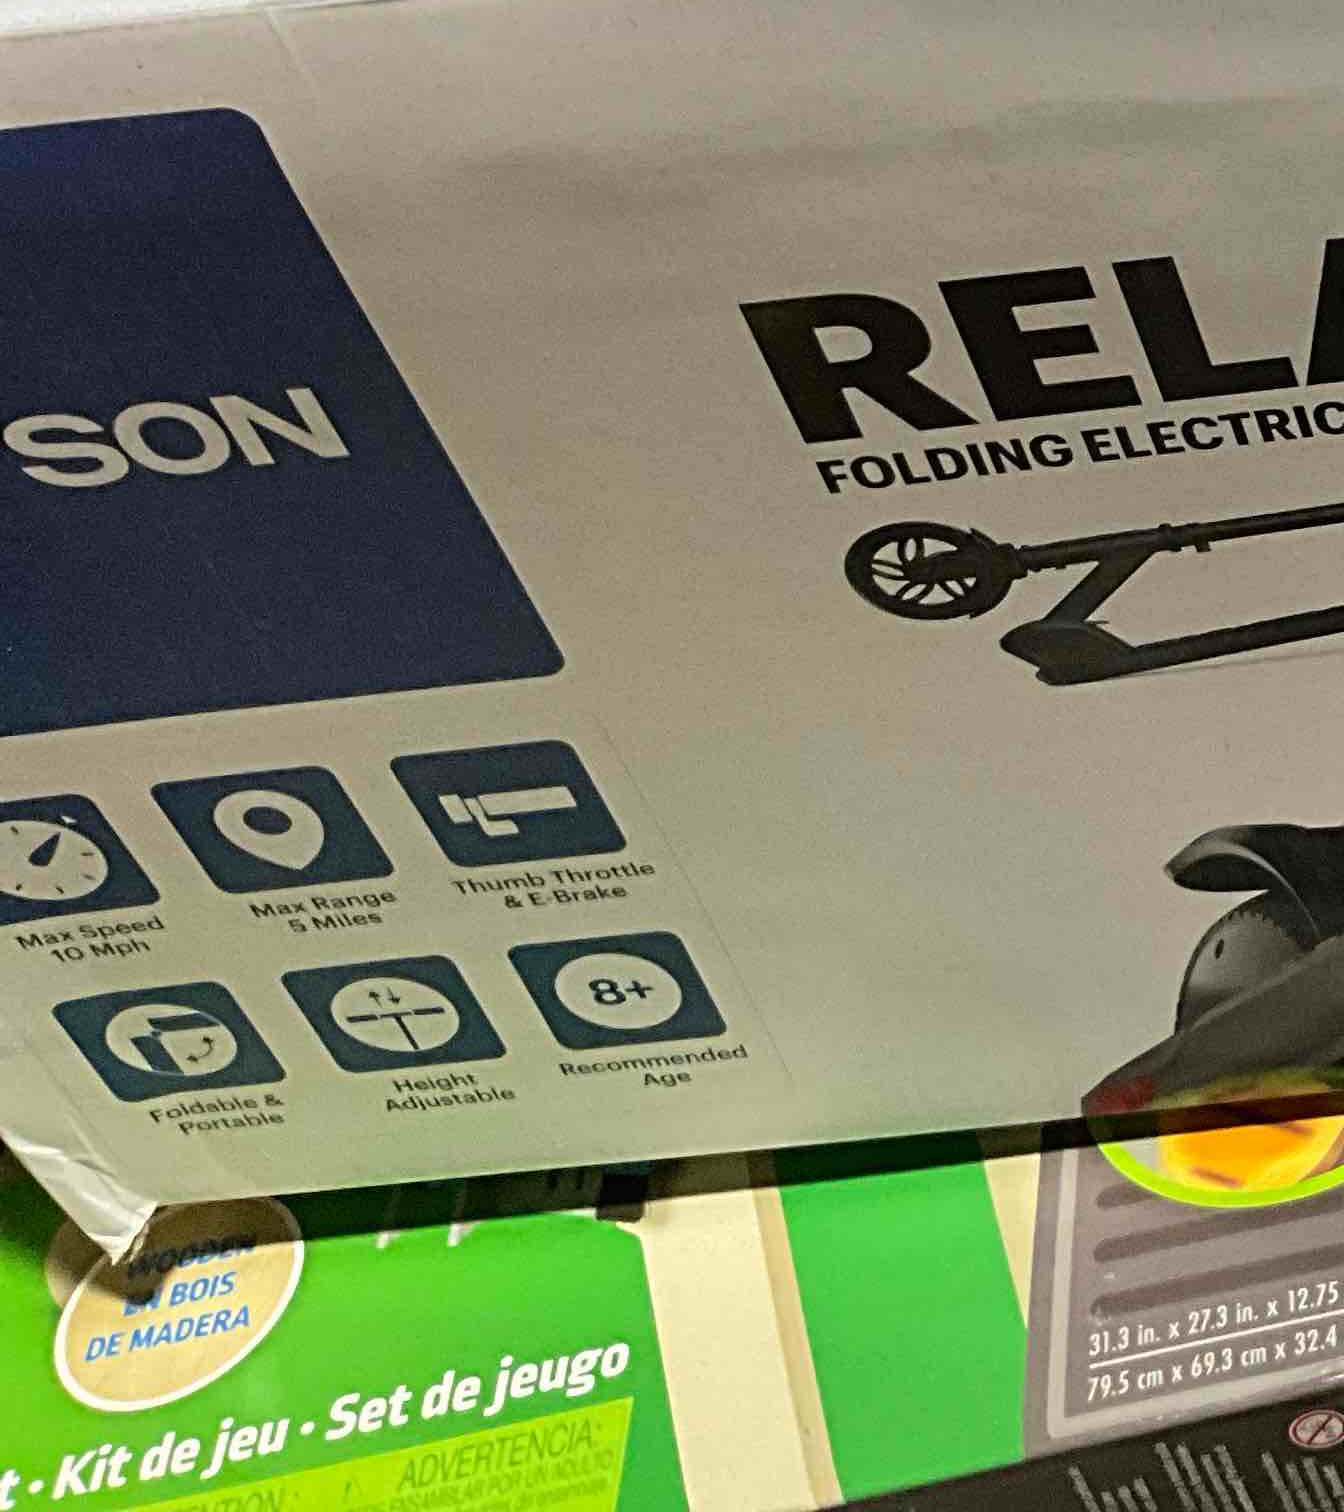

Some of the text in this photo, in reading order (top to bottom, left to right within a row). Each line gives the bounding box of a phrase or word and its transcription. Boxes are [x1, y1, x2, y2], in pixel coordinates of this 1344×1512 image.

[3, 387, 350, 489] SON
[815, 433, 1074, 494] FOLDING
[451, 862, 655, 895] Thumb Throttle
[249, 891, 397, 918] Max Range
[504, 885, 627, 909] & E-Brake
[16, 915, 166, 950] Max Speed
[287, 913, 383, 933] 5 Miles
[50, 938, 151, 963] 10 Mph
[588, 978, 653, 1006] 8+
[558, 1043, 749, 1077] Recommended
[392, 1073, 478, 1094] Height
[643, 1072, 692, 1088] Age
[148, 1094, 284, 1124] Foldable &
[386, 1086, 516, 1113] Adjustable
[177, 1112, 285, 1136] Portable
[168, 1271, 236, 1309] BOIS
[84, 1305, 251, 1362] DE MADERA
[1088, 1325, 1130, 1357] 31.3
[1137, 1324, 1161, 1346] in.
[1168, 1321, 1180, 1339] x
[1188, 1304, 1228, 1335] 27.3
[1235, 1302, 1259, 1324] in.
[1267, 1300, 1279, 1317] x
[1288, 1280, 1339, 1313] 12.75
[1087, 1369, 1130, 1402] 79.5
[1137, 1369, 1164, 1390] cm
[1171, 1365, 1183, 1383] x
[1190, 1347, 1233, 1379] 69.3
[1240, 1346, 1267, 1367] cm
[1274, 1342, 1286, 1360] x
[1294, 1324, 1337, 1356] 32.4
[52, 1445, 129, 1500] Kit
[140, 1432, 197, 1480] de
[201, 1415, 289, 1480] jeu
[324, 1383, 408, 1442] Set
[420, 1369, 478, 1420] de
[484, 1341, 632, 1418] jeugo
